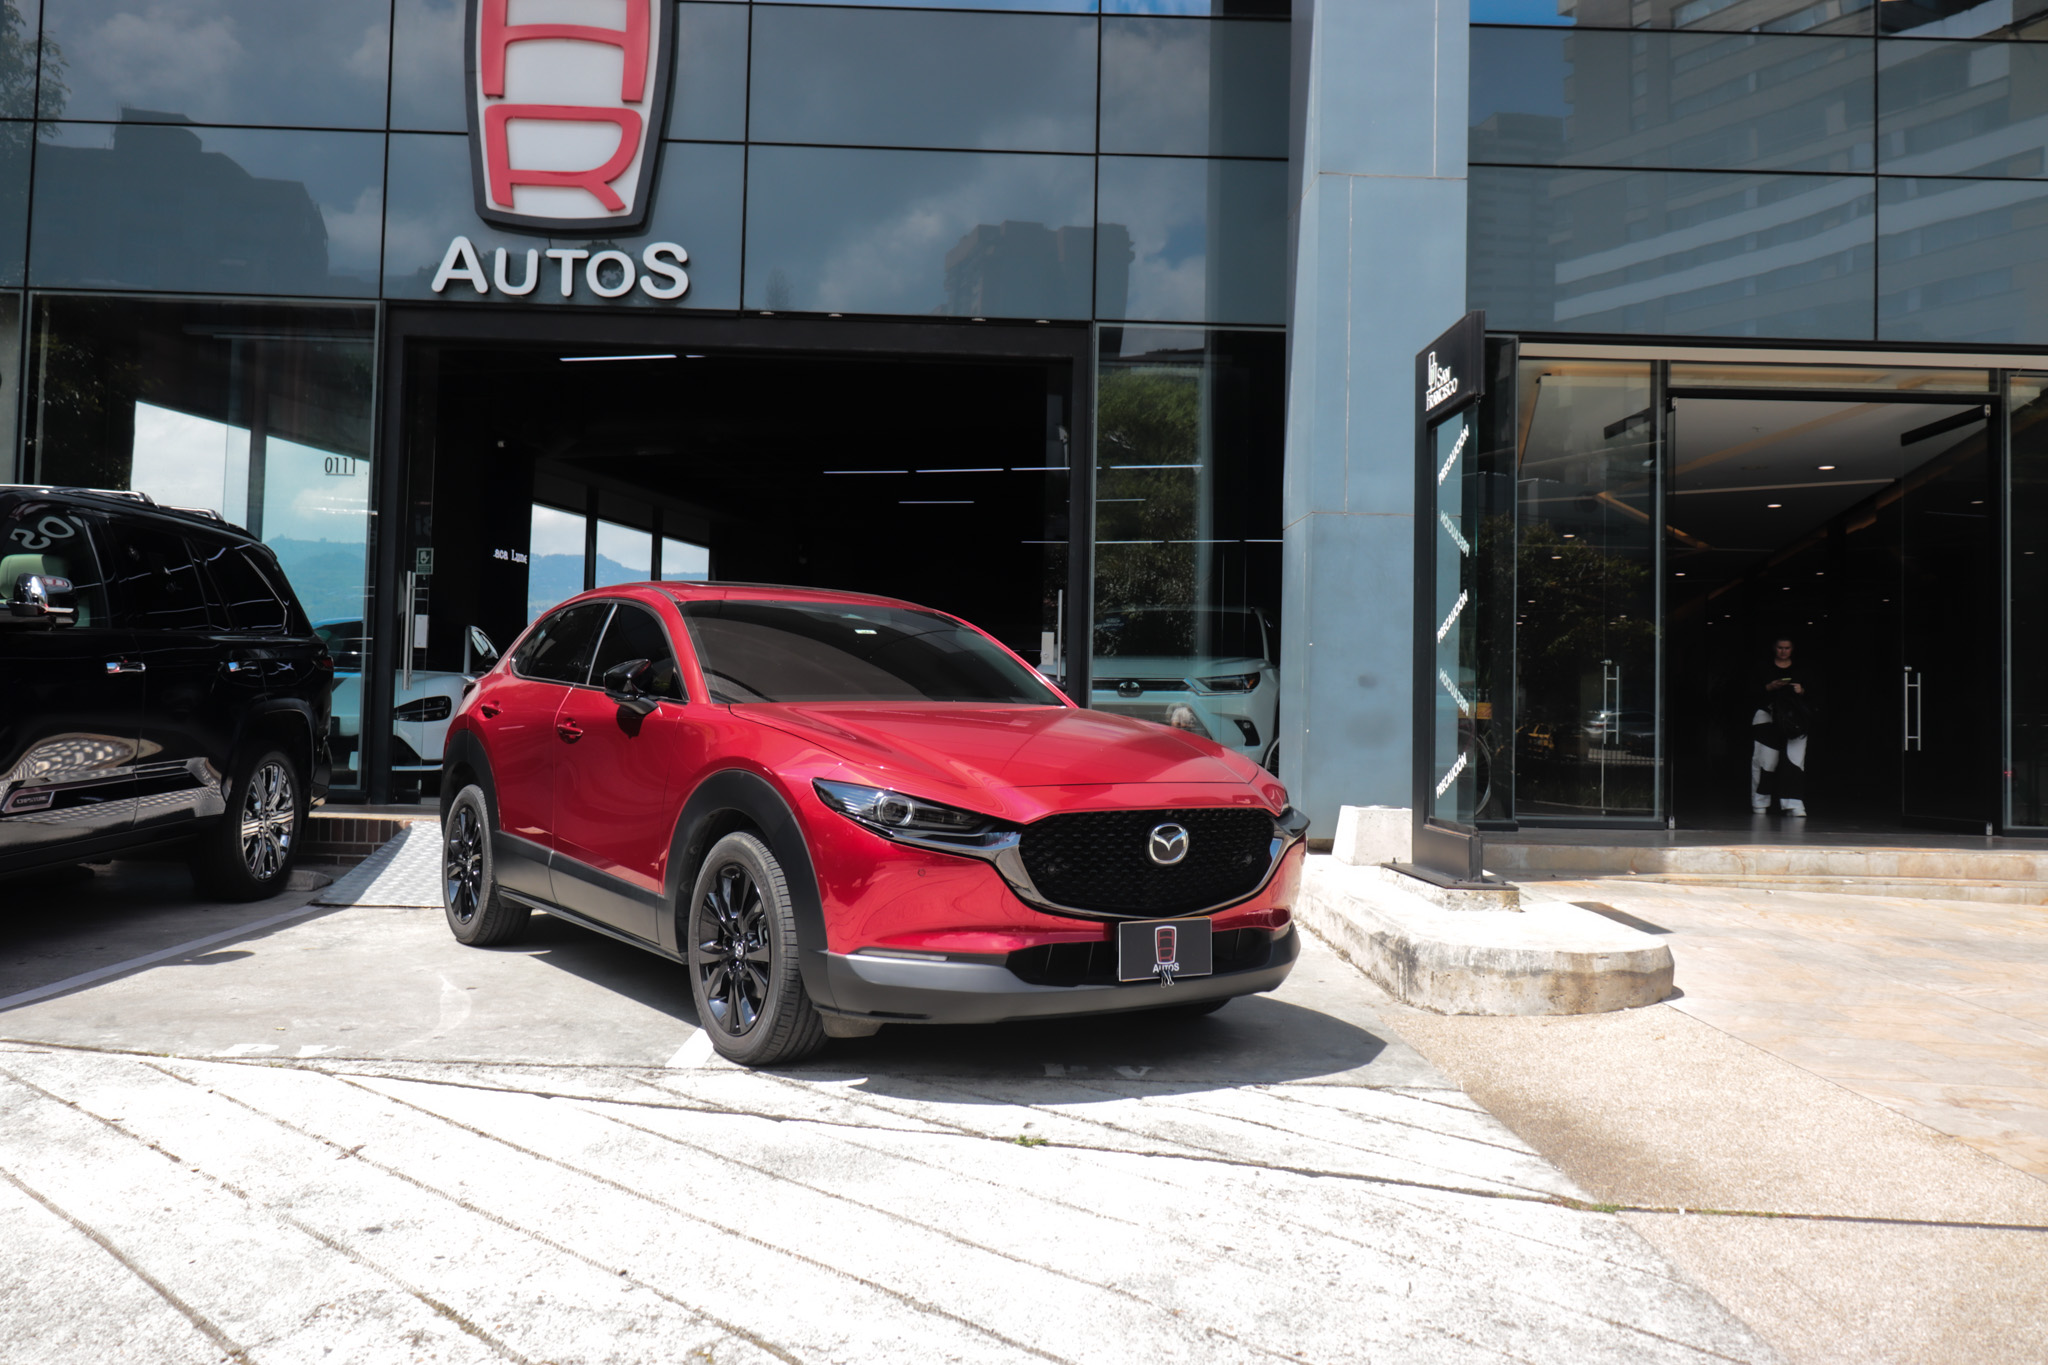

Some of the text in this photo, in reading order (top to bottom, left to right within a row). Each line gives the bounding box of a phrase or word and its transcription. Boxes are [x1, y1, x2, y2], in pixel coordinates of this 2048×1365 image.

[431, 235, 689, 299] AUTOS
[1425, 377, 1458, 412] FRANCISCO
[325, 457, 356, 475] 0111
[1438, 424, 1470, 486] PRECAUCIÓN
[1437, 589, 1468, 643] PRECAUCIÓN
[1436, 751, 1467, 799] PRECAUCIÓN
